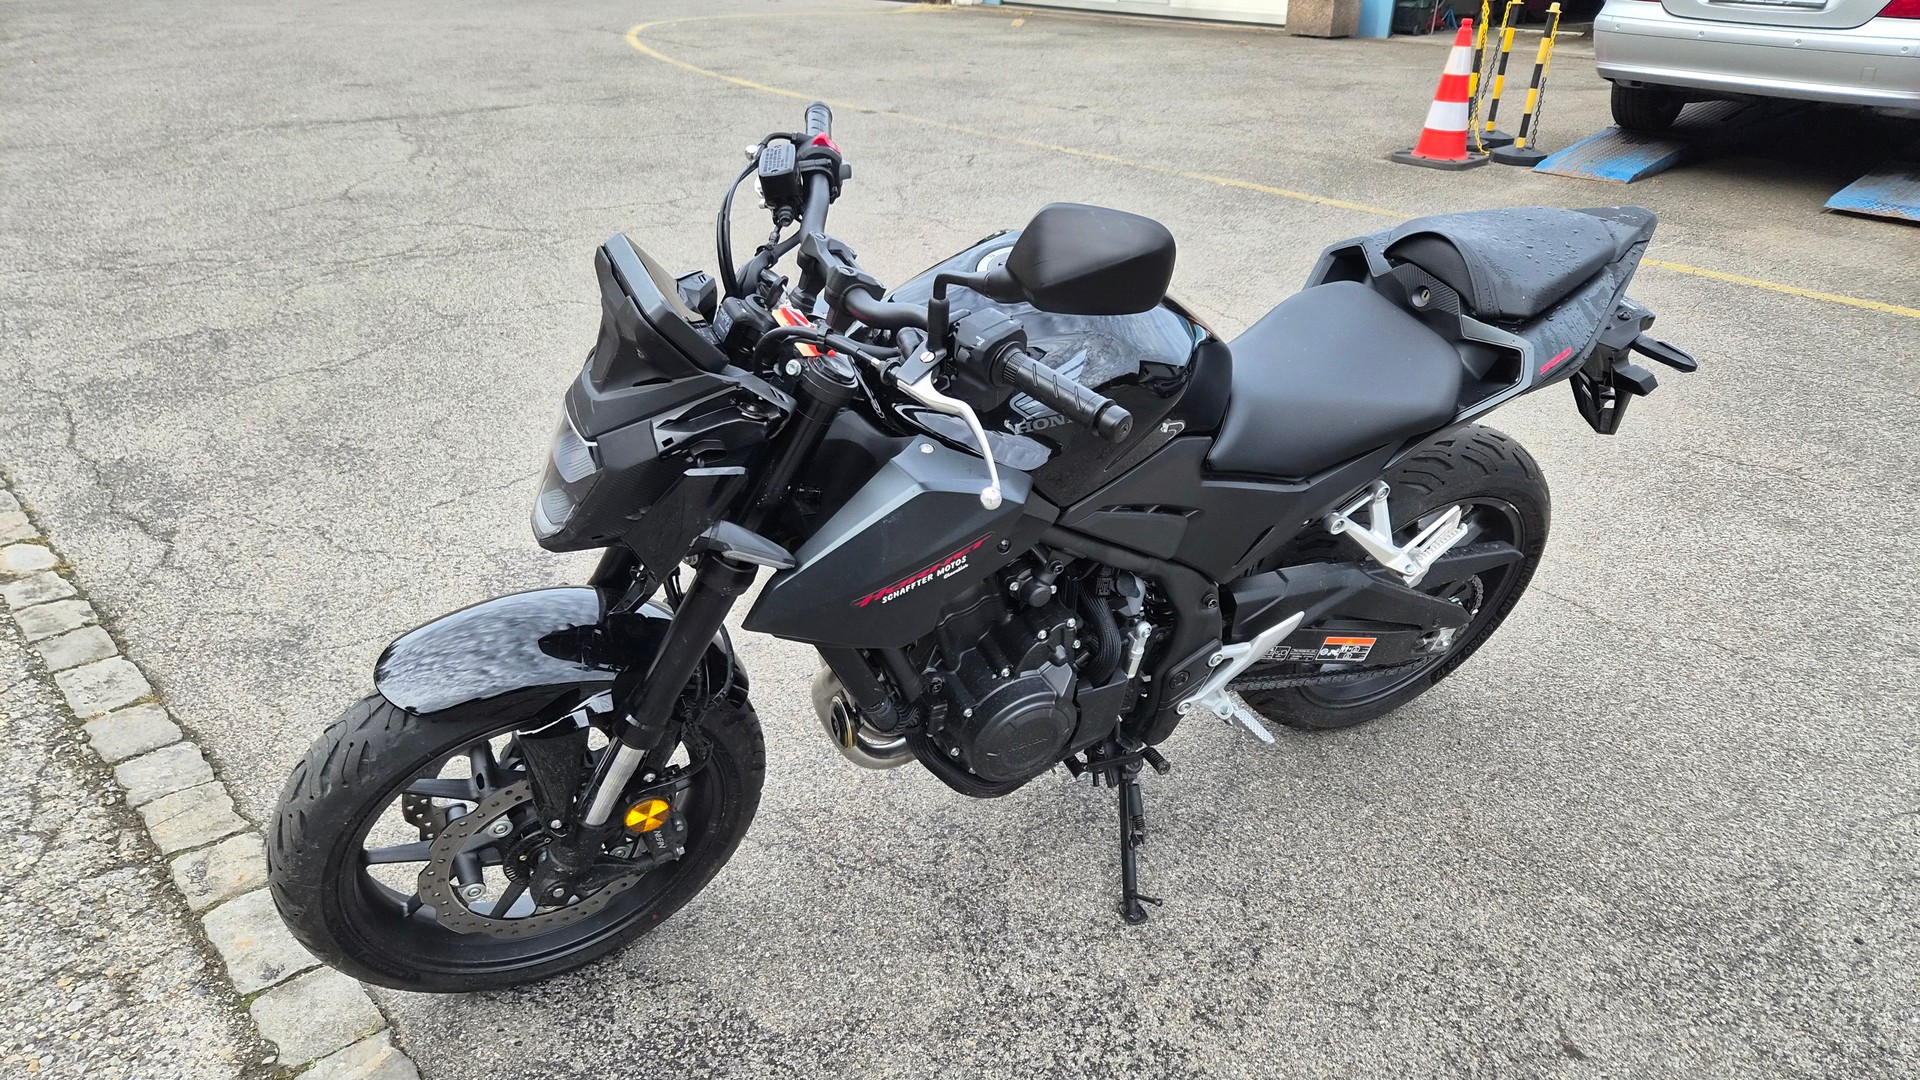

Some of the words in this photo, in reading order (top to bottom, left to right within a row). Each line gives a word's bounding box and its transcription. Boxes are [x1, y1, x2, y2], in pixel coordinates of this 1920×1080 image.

[1014, 414, 1074, 435] HON
[881, 573, 934, 604] SCHAFFTER
[936, 555, 967, 578] MOTOS
[1500, 556, 1536, 614] MICHELIN
[1464, 616, 1499, 656] 160/60
[1435, 667, 1447, 680] 17
[1448, 654, 1463, 670] ZR
